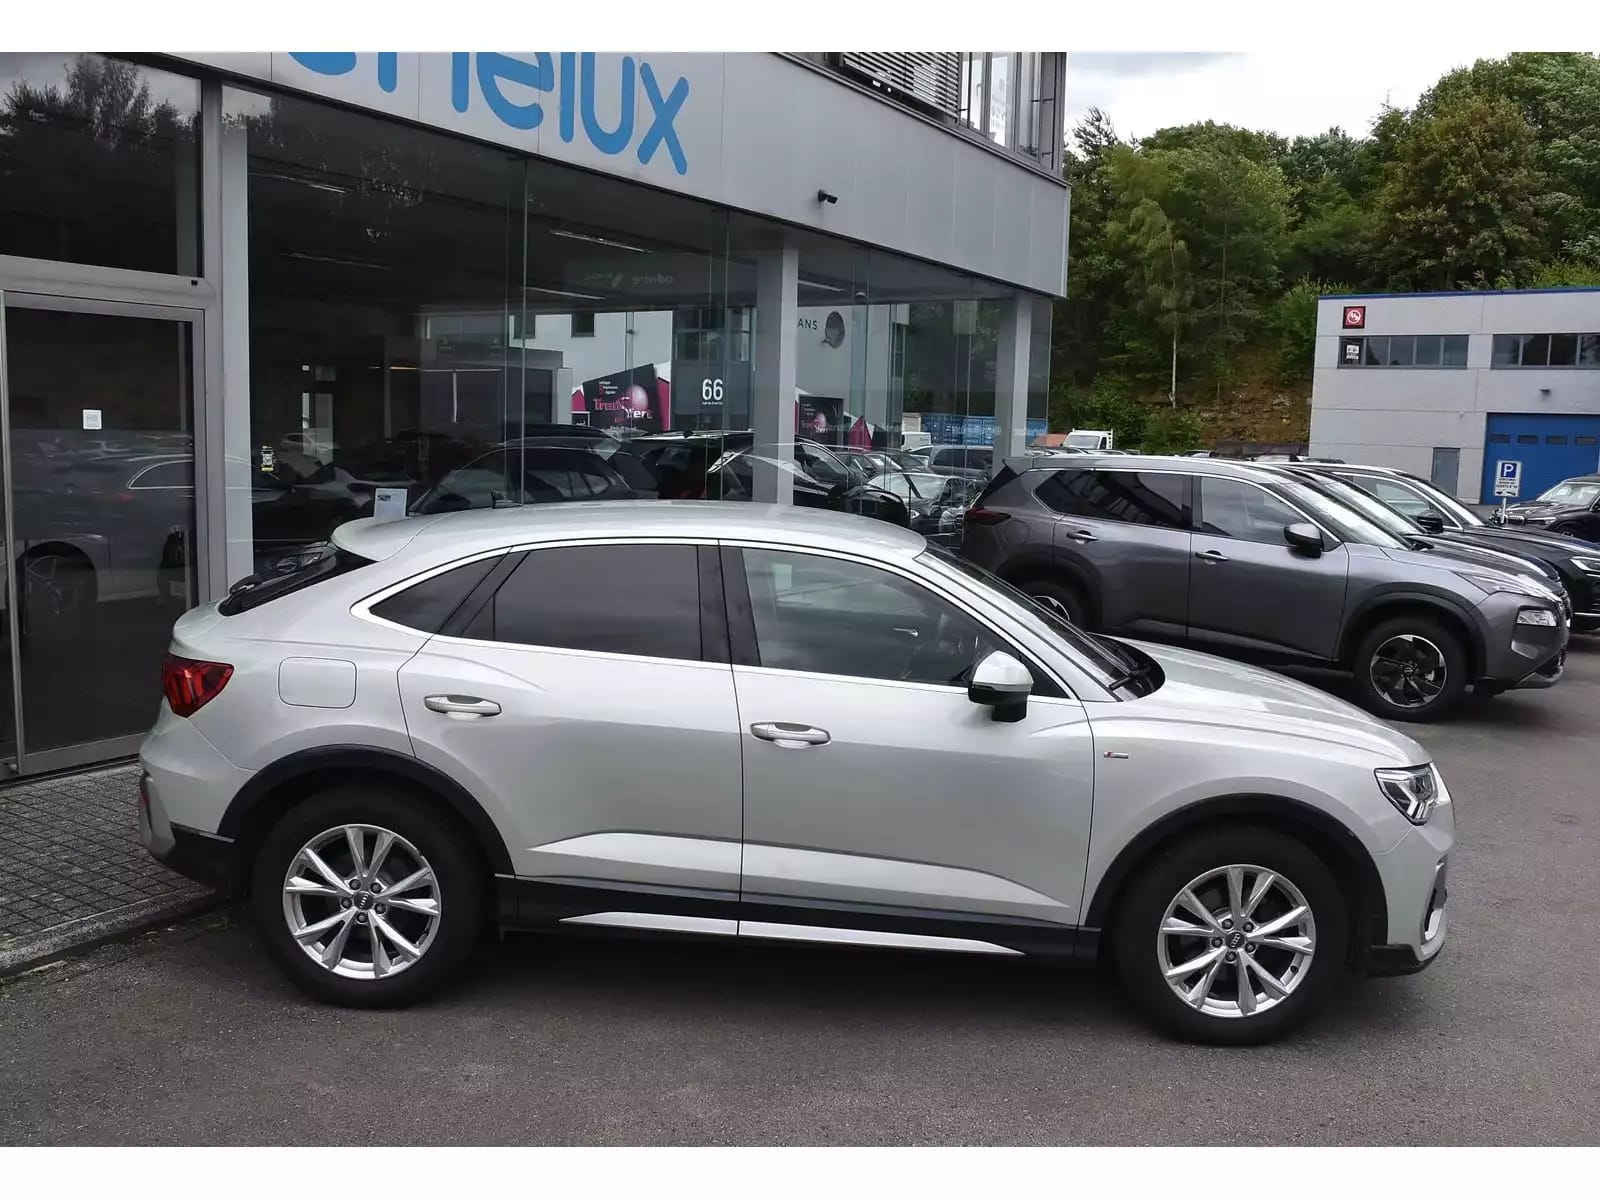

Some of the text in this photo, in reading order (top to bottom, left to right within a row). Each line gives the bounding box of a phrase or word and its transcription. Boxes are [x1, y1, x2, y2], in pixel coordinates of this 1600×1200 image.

[287, 52, 690, 175] elux
[702, 378, 723, 401] 66
[1503, 463, 1514, 477] P
